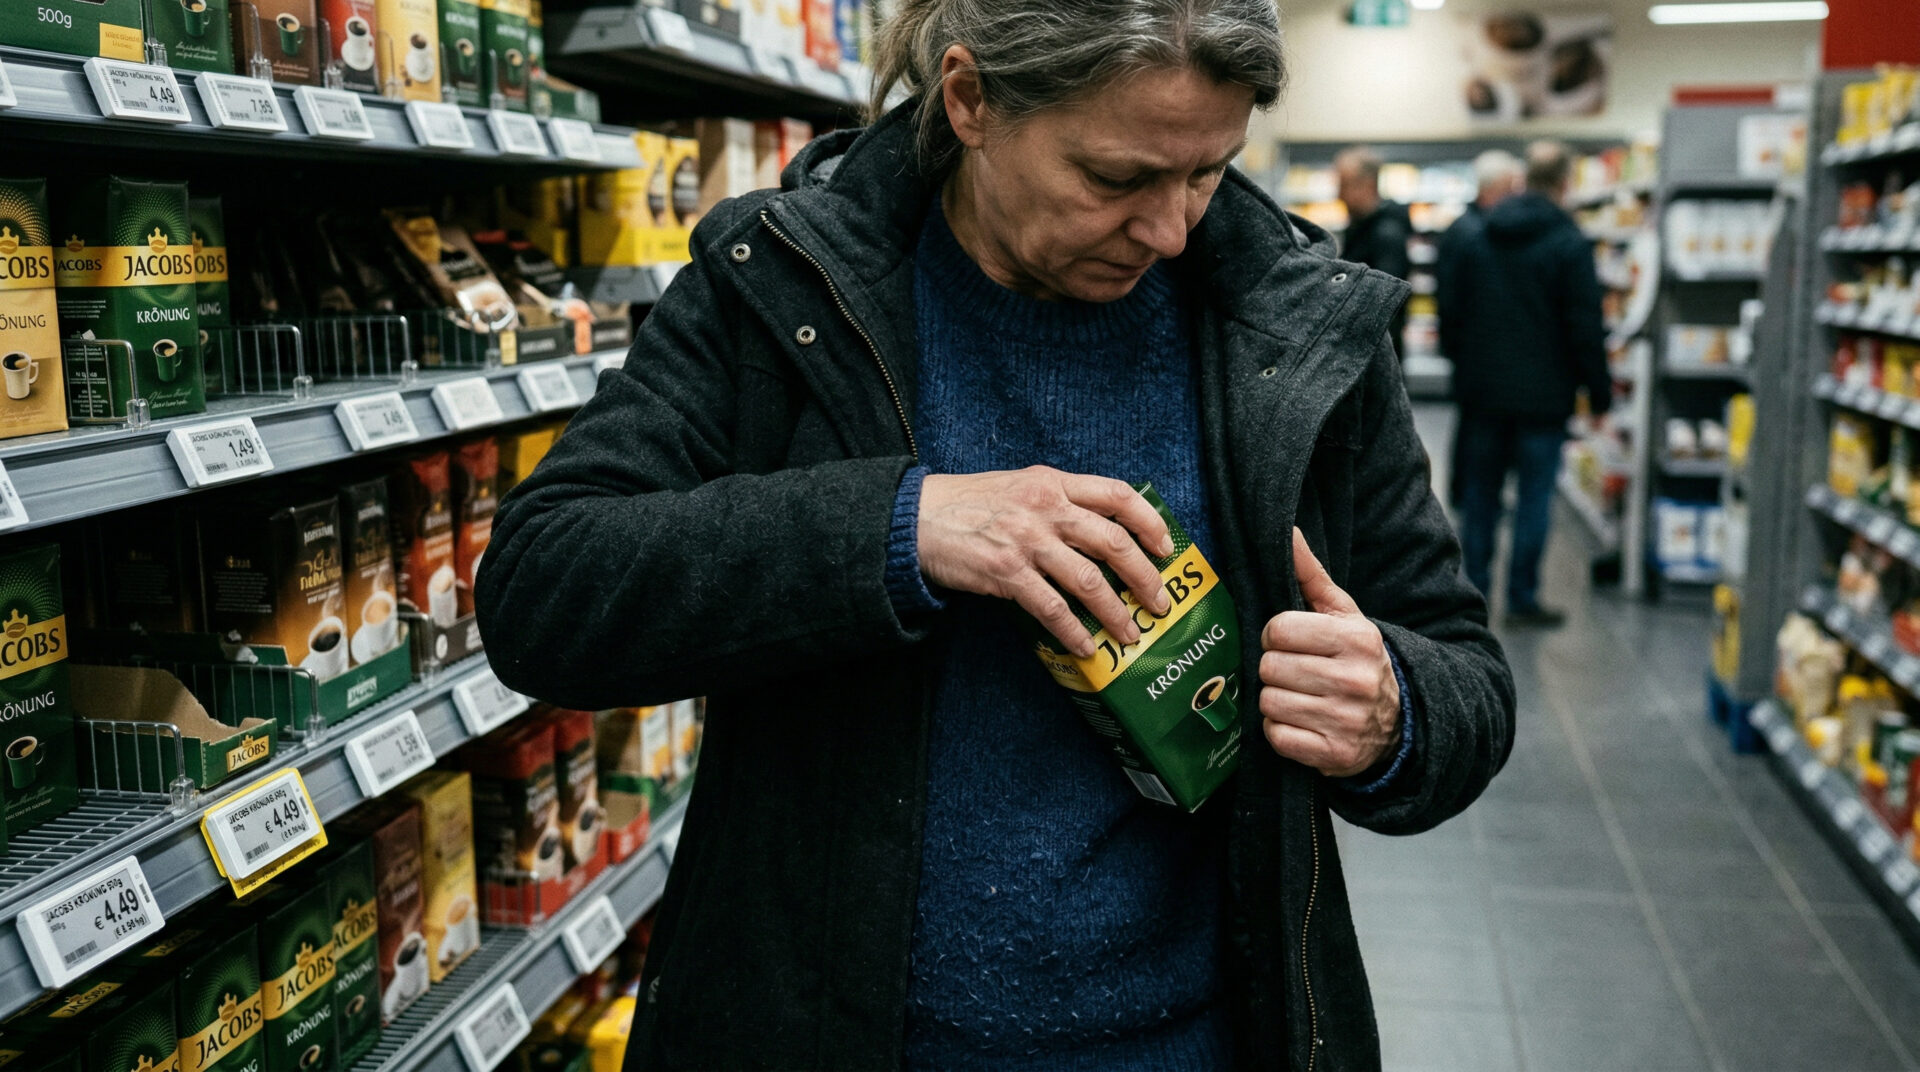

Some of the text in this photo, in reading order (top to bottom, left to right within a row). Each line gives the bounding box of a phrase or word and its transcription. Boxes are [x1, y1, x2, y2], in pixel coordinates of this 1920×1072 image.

[38, 7, 72, 28] 500g
[124, 254, 193, 281] JACOBS
[194, 254, 225, 275] OBS
[136, 306, 191, 324] KRÖNUNG
[198, 302, 221, 316] UNG
[0, 627, 60, 668] COBS
[1146, 623, 1226, 701] KRÖNUNG
[232, 740, 266, 769] JACOBS
[265, 820, 273, 834] €
[273, 799, 300, 829] 4.49
[94, 916, 104, 930] €
[104, 888, 139, 923] 4.49
[333, 911, 376, 950] ACOBS
[276, 953, 334, 1012] JACOBS
[195, 1000, 262, 1069] JACOBS
